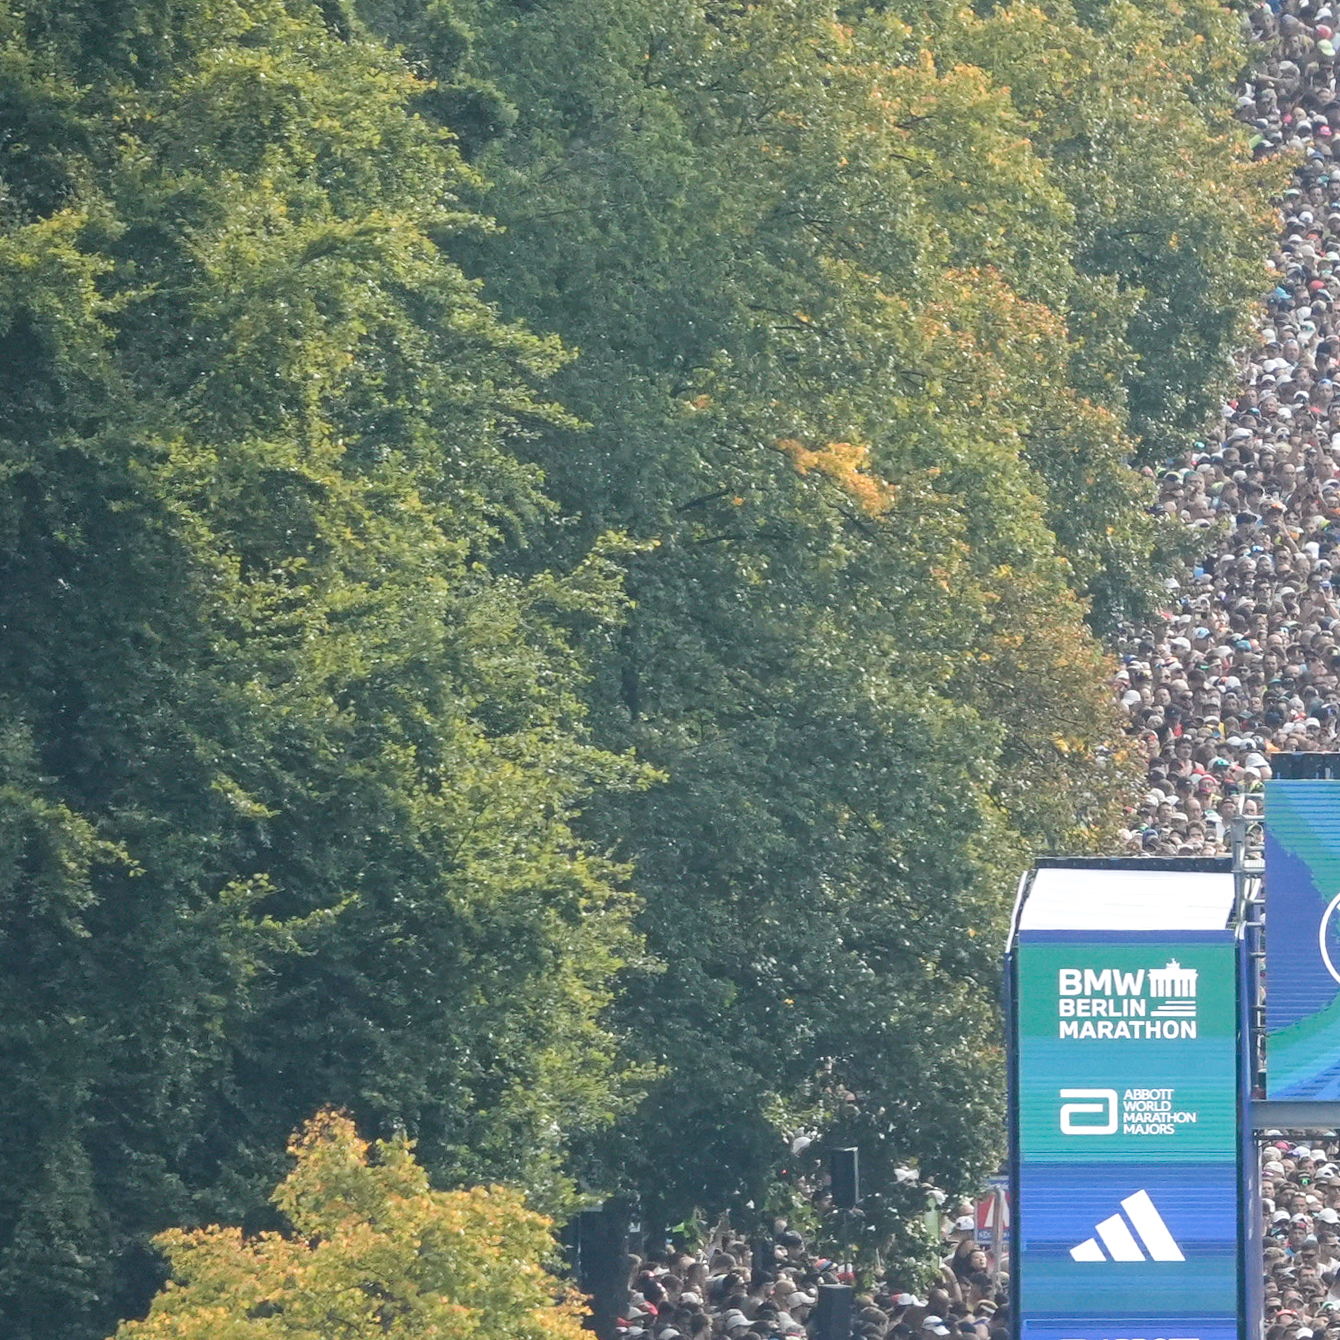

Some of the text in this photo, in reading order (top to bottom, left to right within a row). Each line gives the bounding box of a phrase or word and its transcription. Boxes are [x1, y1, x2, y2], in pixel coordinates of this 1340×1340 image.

[1059, 969, 1144, 996] BMW
[1059, 999, 1145, 1017] BERLIN
[1059, 1020, 1195, 1039] MARATHON
[1123, 1089, 1174, 1101] ABBOTT
[1123, 1101, 1171, 1112] WORLD
[1123, 1113, 1196, 1124] MARATHON
[1123, 1124, 1174, 1135] MAJORS
